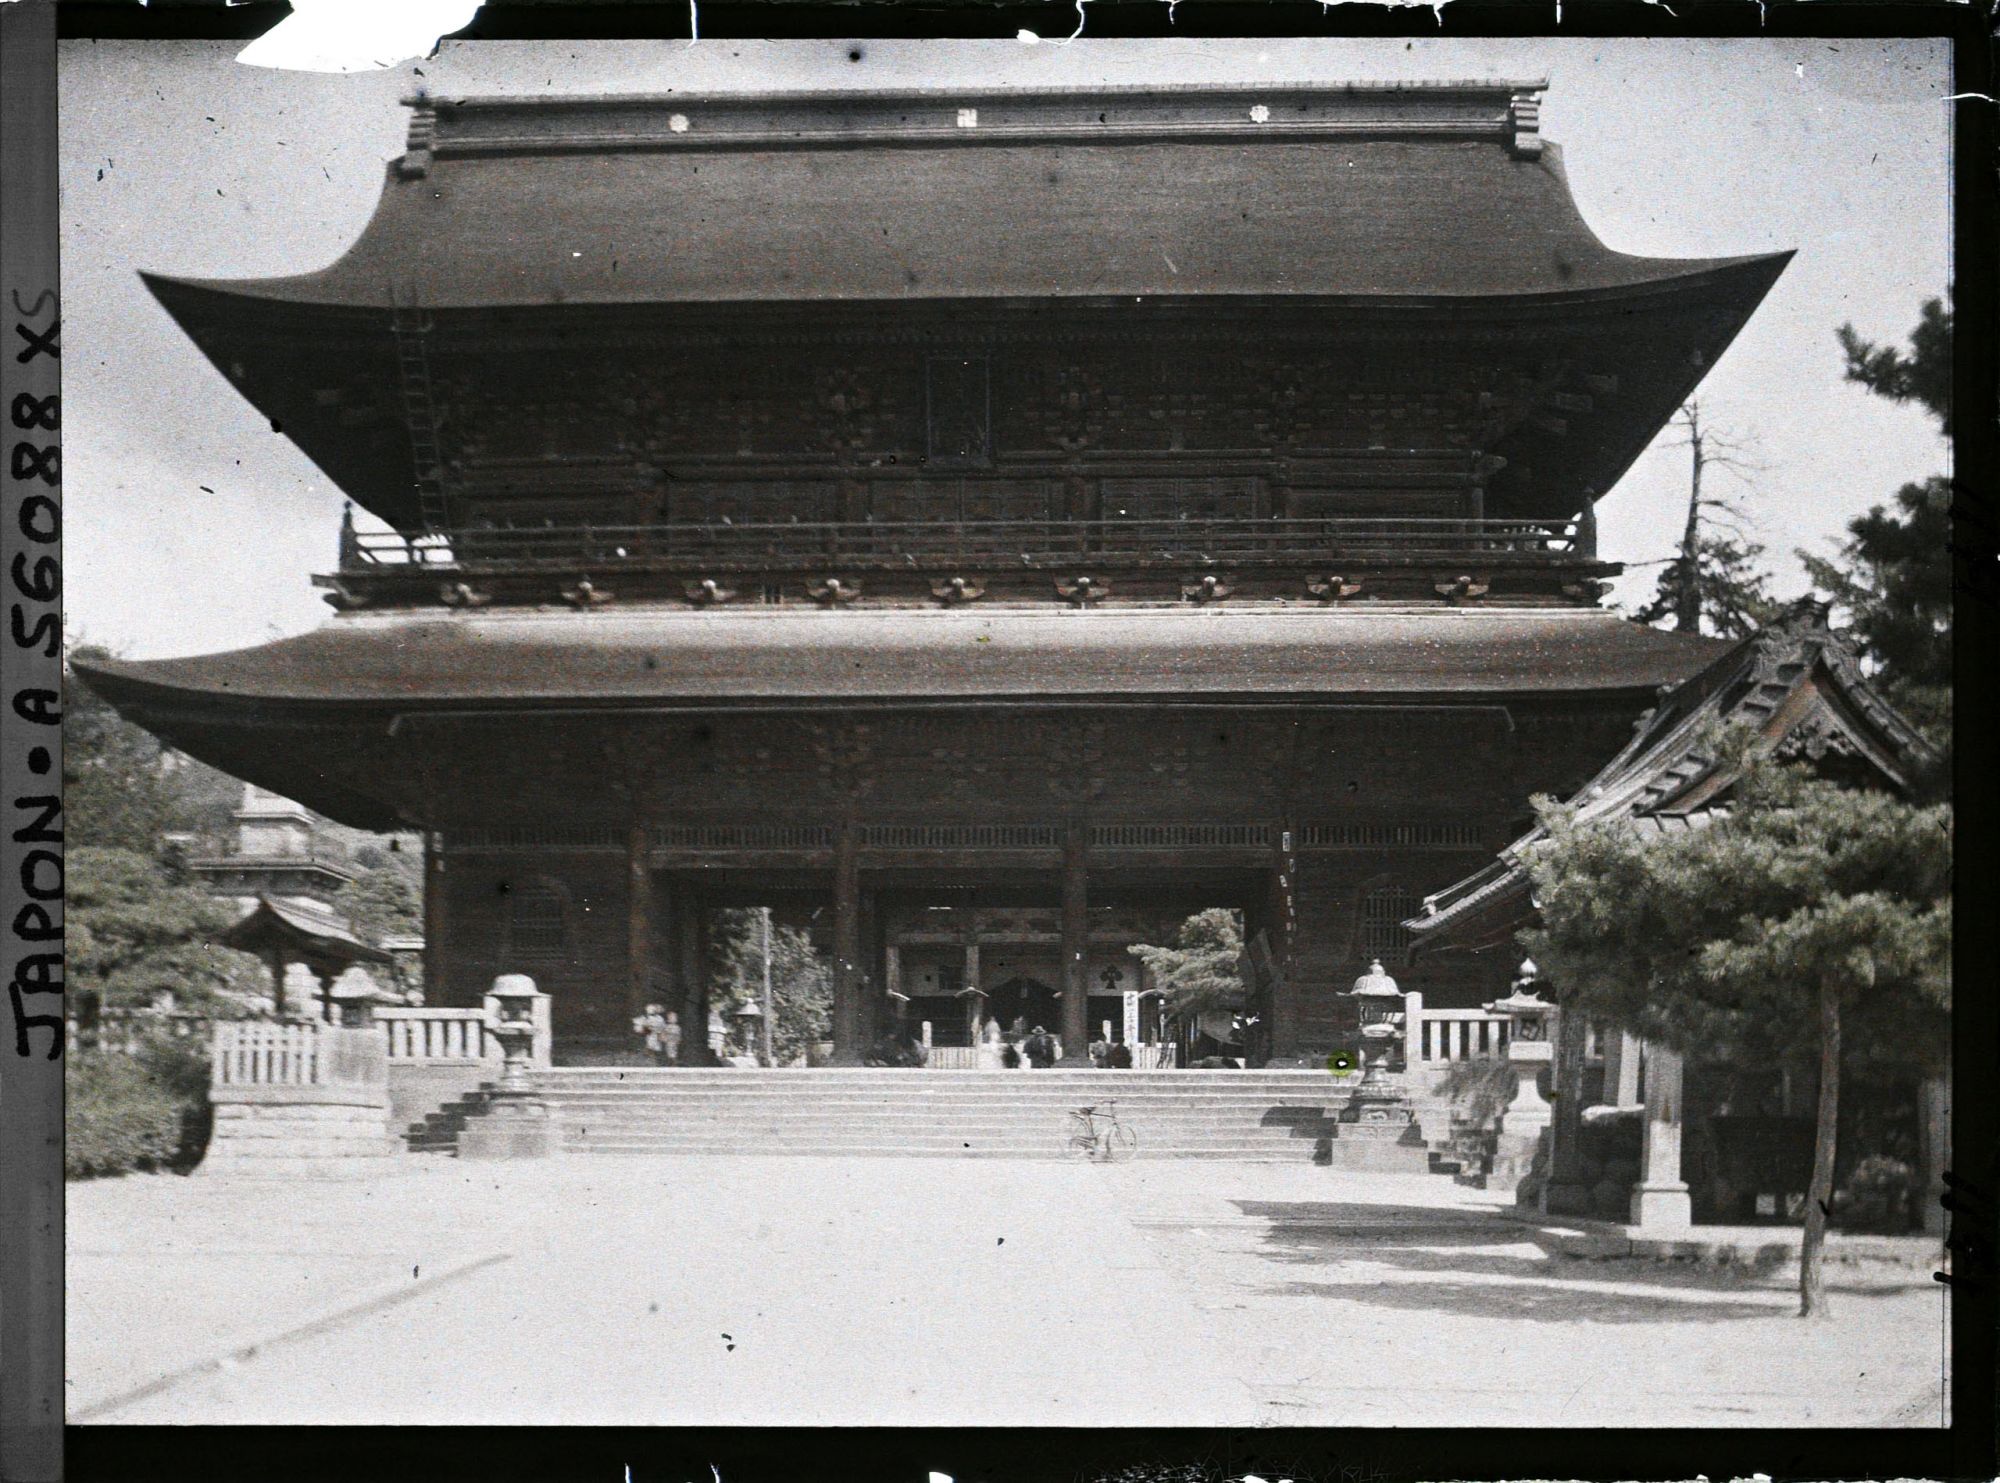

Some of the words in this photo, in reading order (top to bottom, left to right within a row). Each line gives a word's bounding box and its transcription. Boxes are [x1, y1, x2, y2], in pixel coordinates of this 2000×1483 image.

[11, 393, 62, 658] 56088
[11, 688, 61, 732] A
[8, 793, 63, 1062] JAPON
